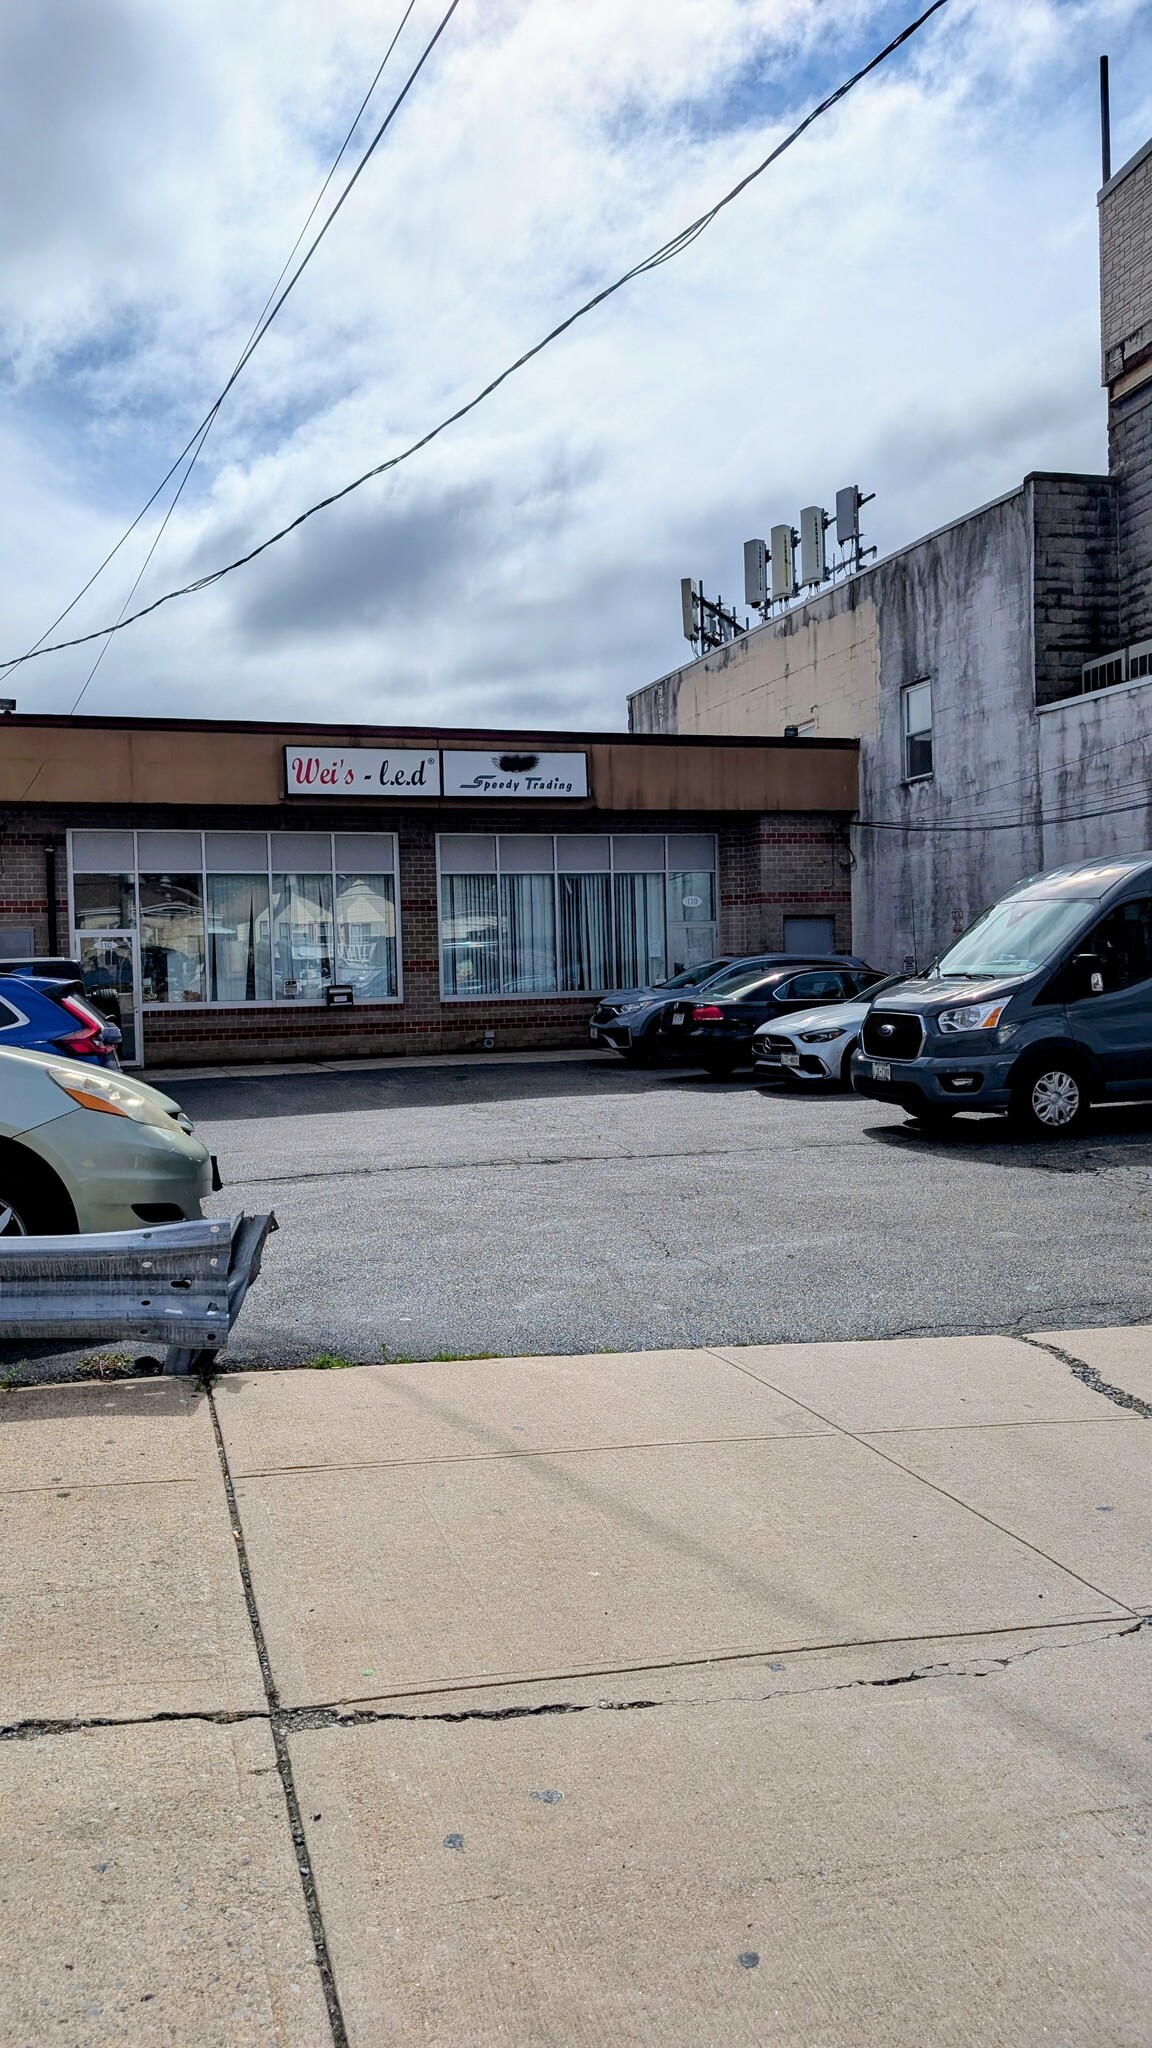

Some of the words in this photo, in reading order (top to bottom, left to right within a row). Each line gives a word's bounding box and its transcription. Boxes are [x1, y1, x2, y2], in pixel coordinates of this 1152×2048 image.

[292, 757, 354, 785] Wei's
[459, 775, 520, 792] Speedy
[525, 777, 573, 792] Trading
